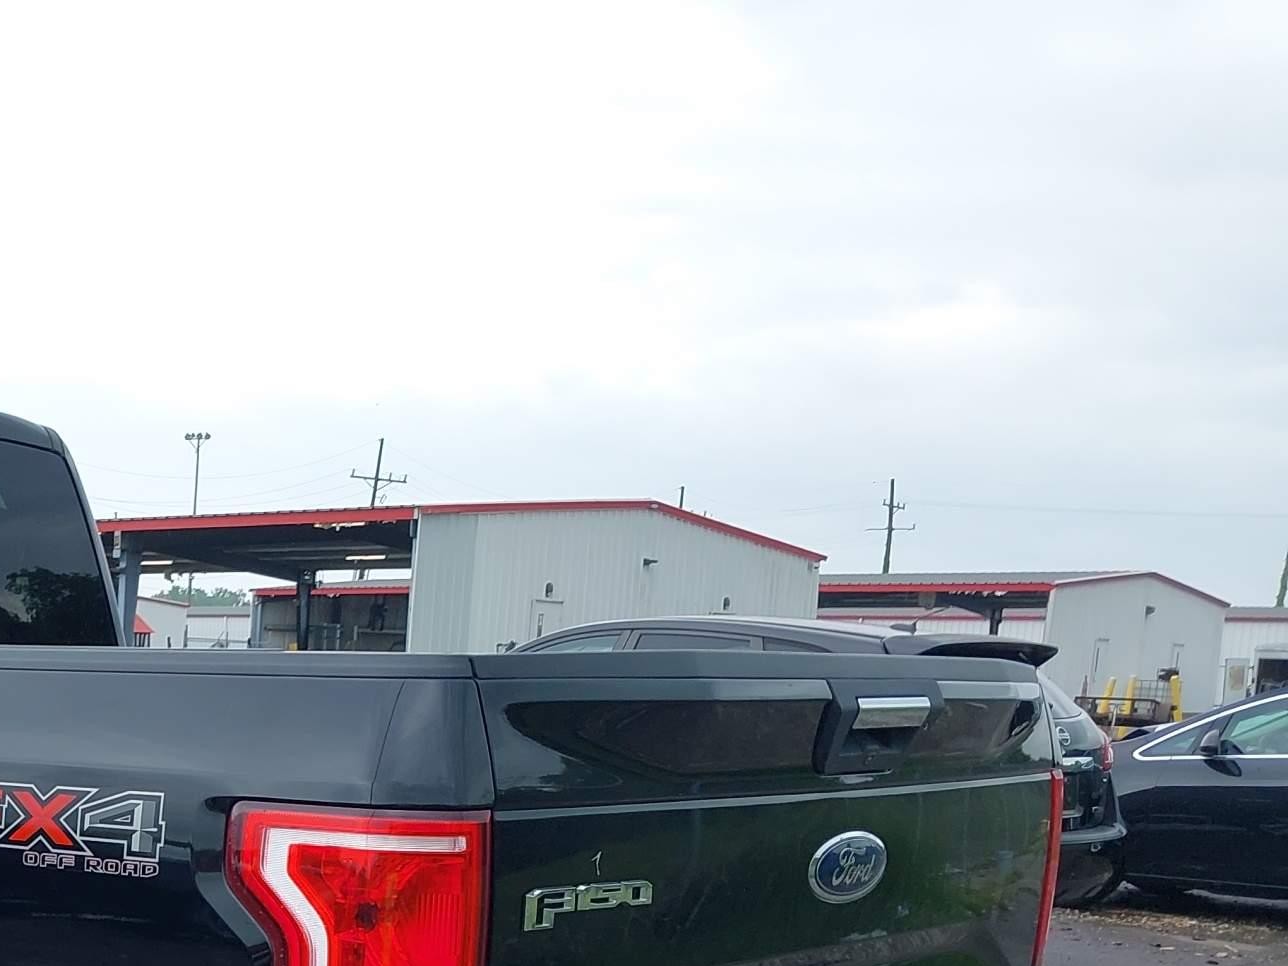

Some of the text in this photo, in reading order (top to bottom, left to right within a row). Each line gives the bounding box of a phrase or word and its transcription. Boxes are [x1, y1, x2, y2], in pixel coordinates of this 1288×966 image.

[23, 852, 159, 877] OFF ROAD
[832, 847, 876, 886] Ford
[524, 880, 652, 931] F150
